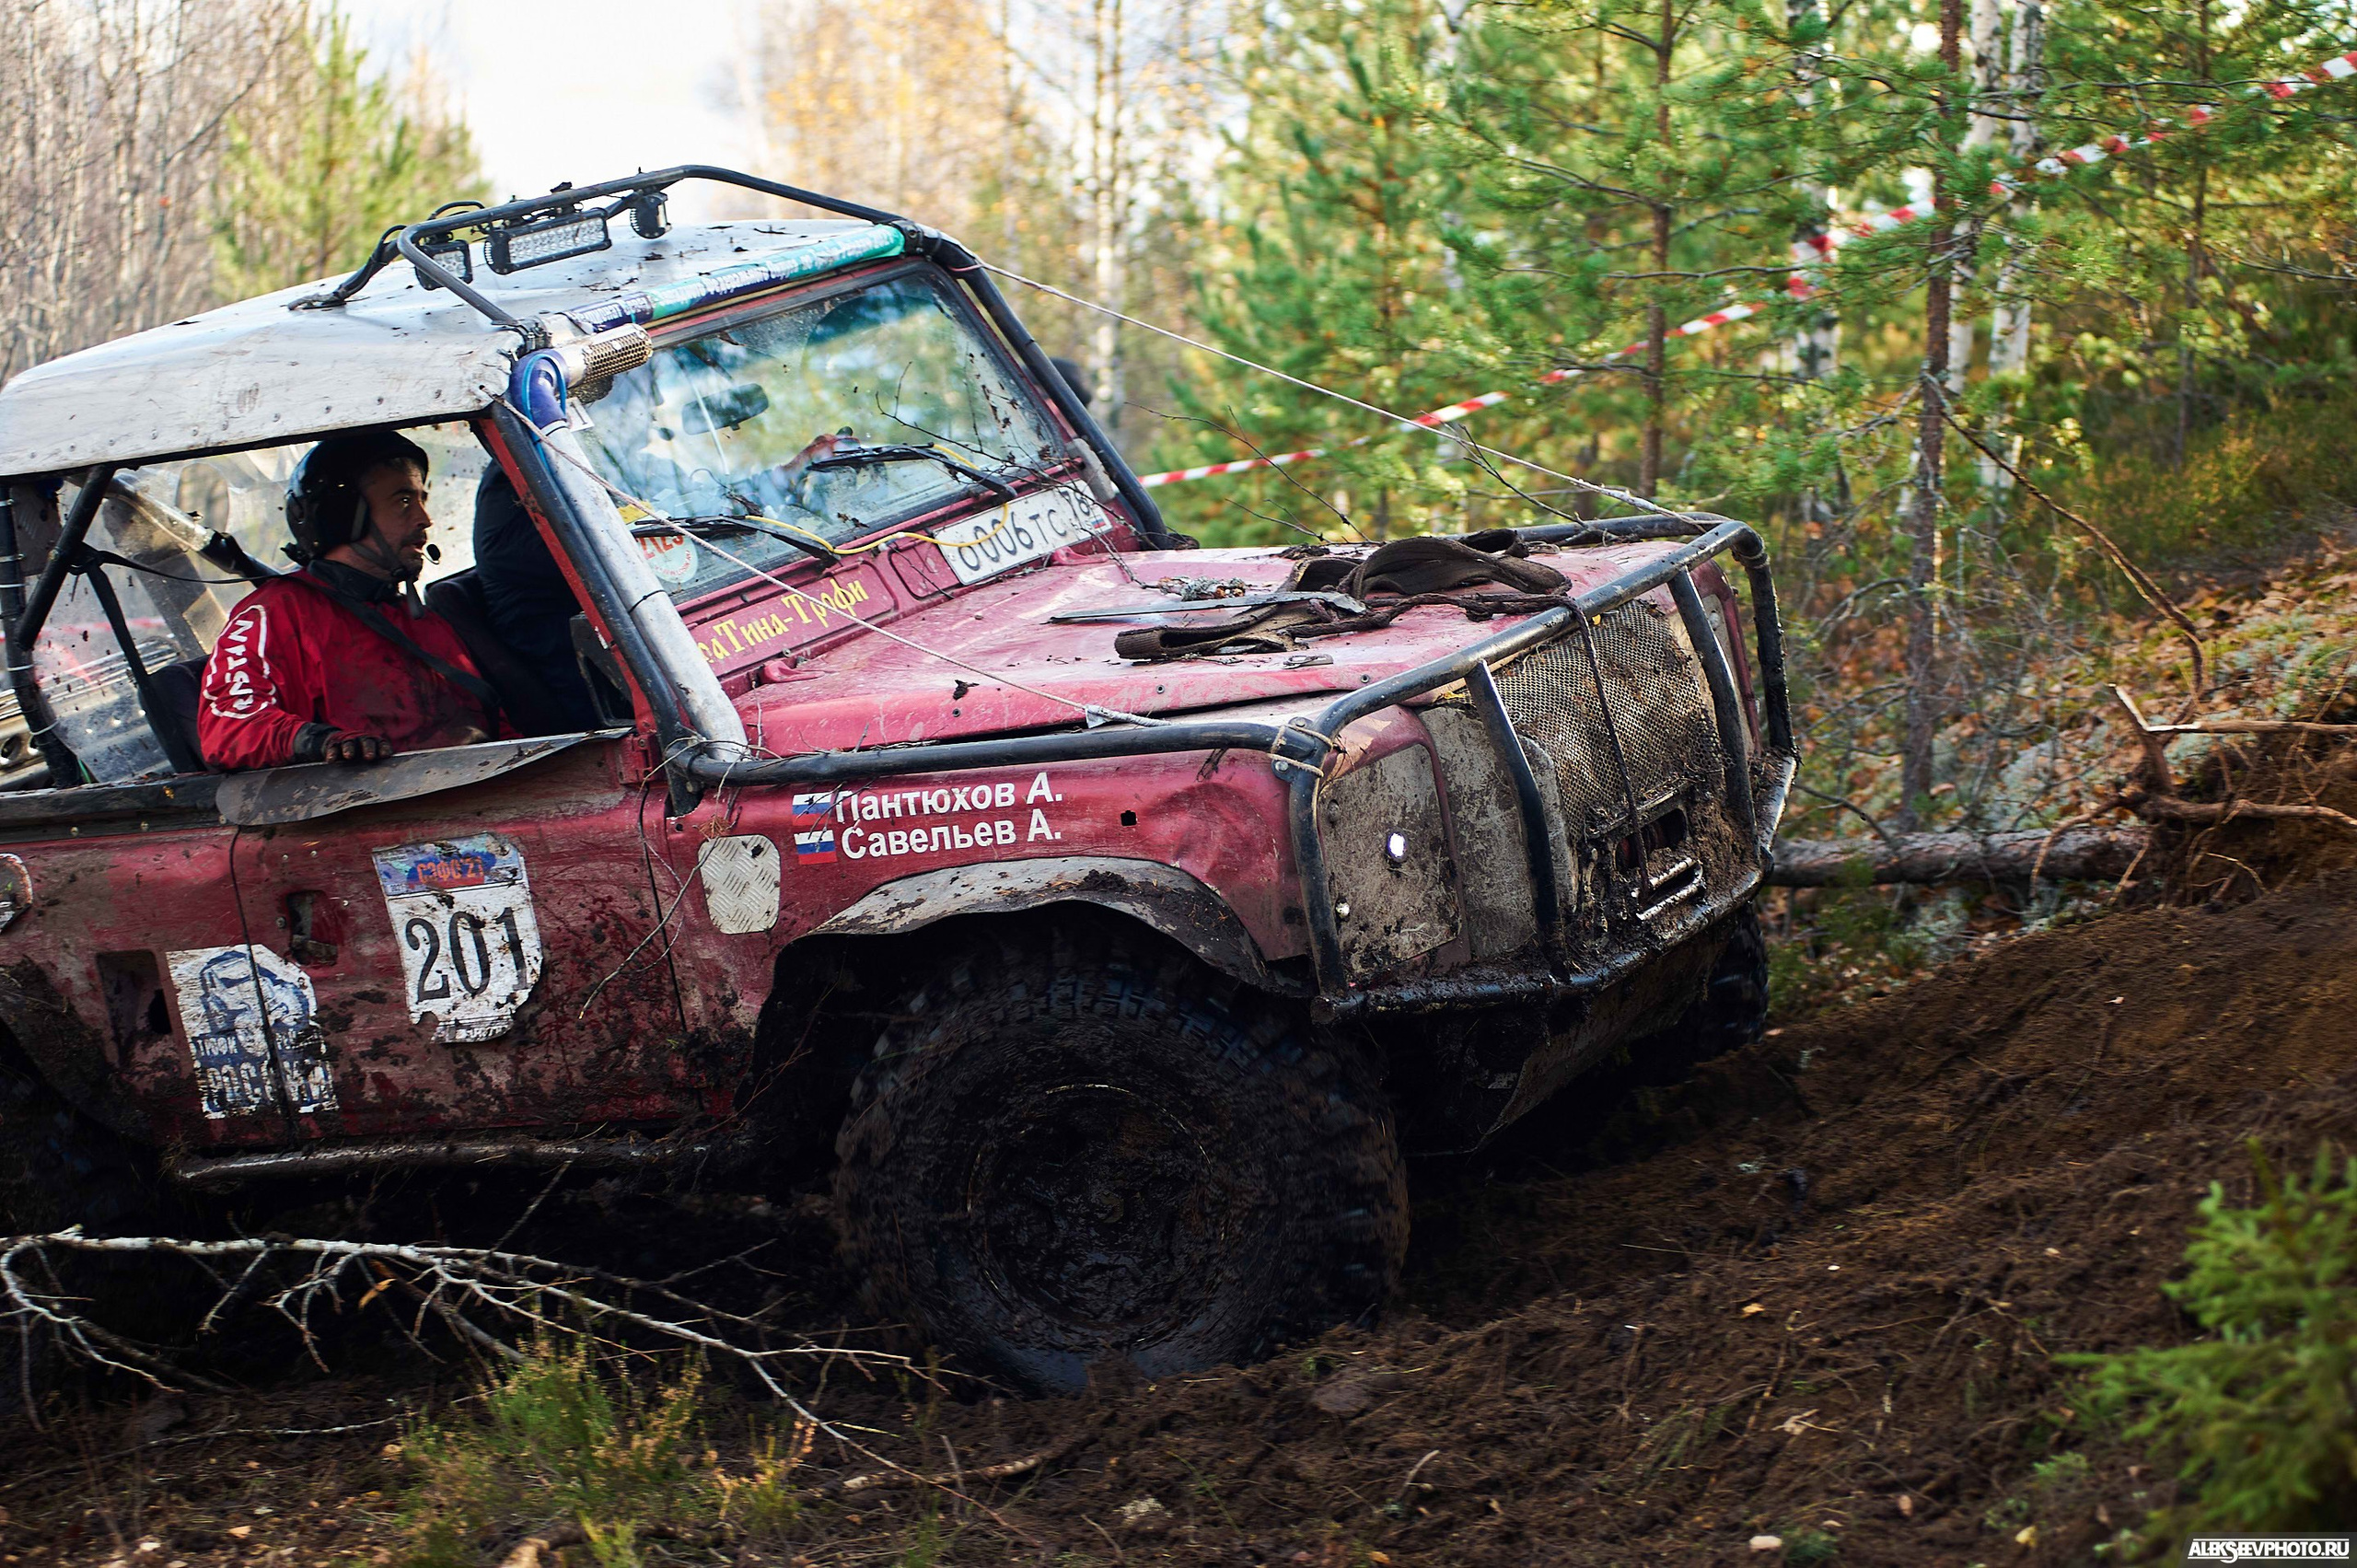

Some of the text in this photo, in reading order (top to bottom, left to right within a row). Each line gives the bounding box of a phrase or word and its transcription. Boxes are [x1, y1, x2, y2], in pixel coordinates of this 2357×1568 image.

[834, 772, 1063, 824] Пантюхов А.
[841, 807, 1062, 860] Савельев А.
[405, 906, 529, 1005] 201
